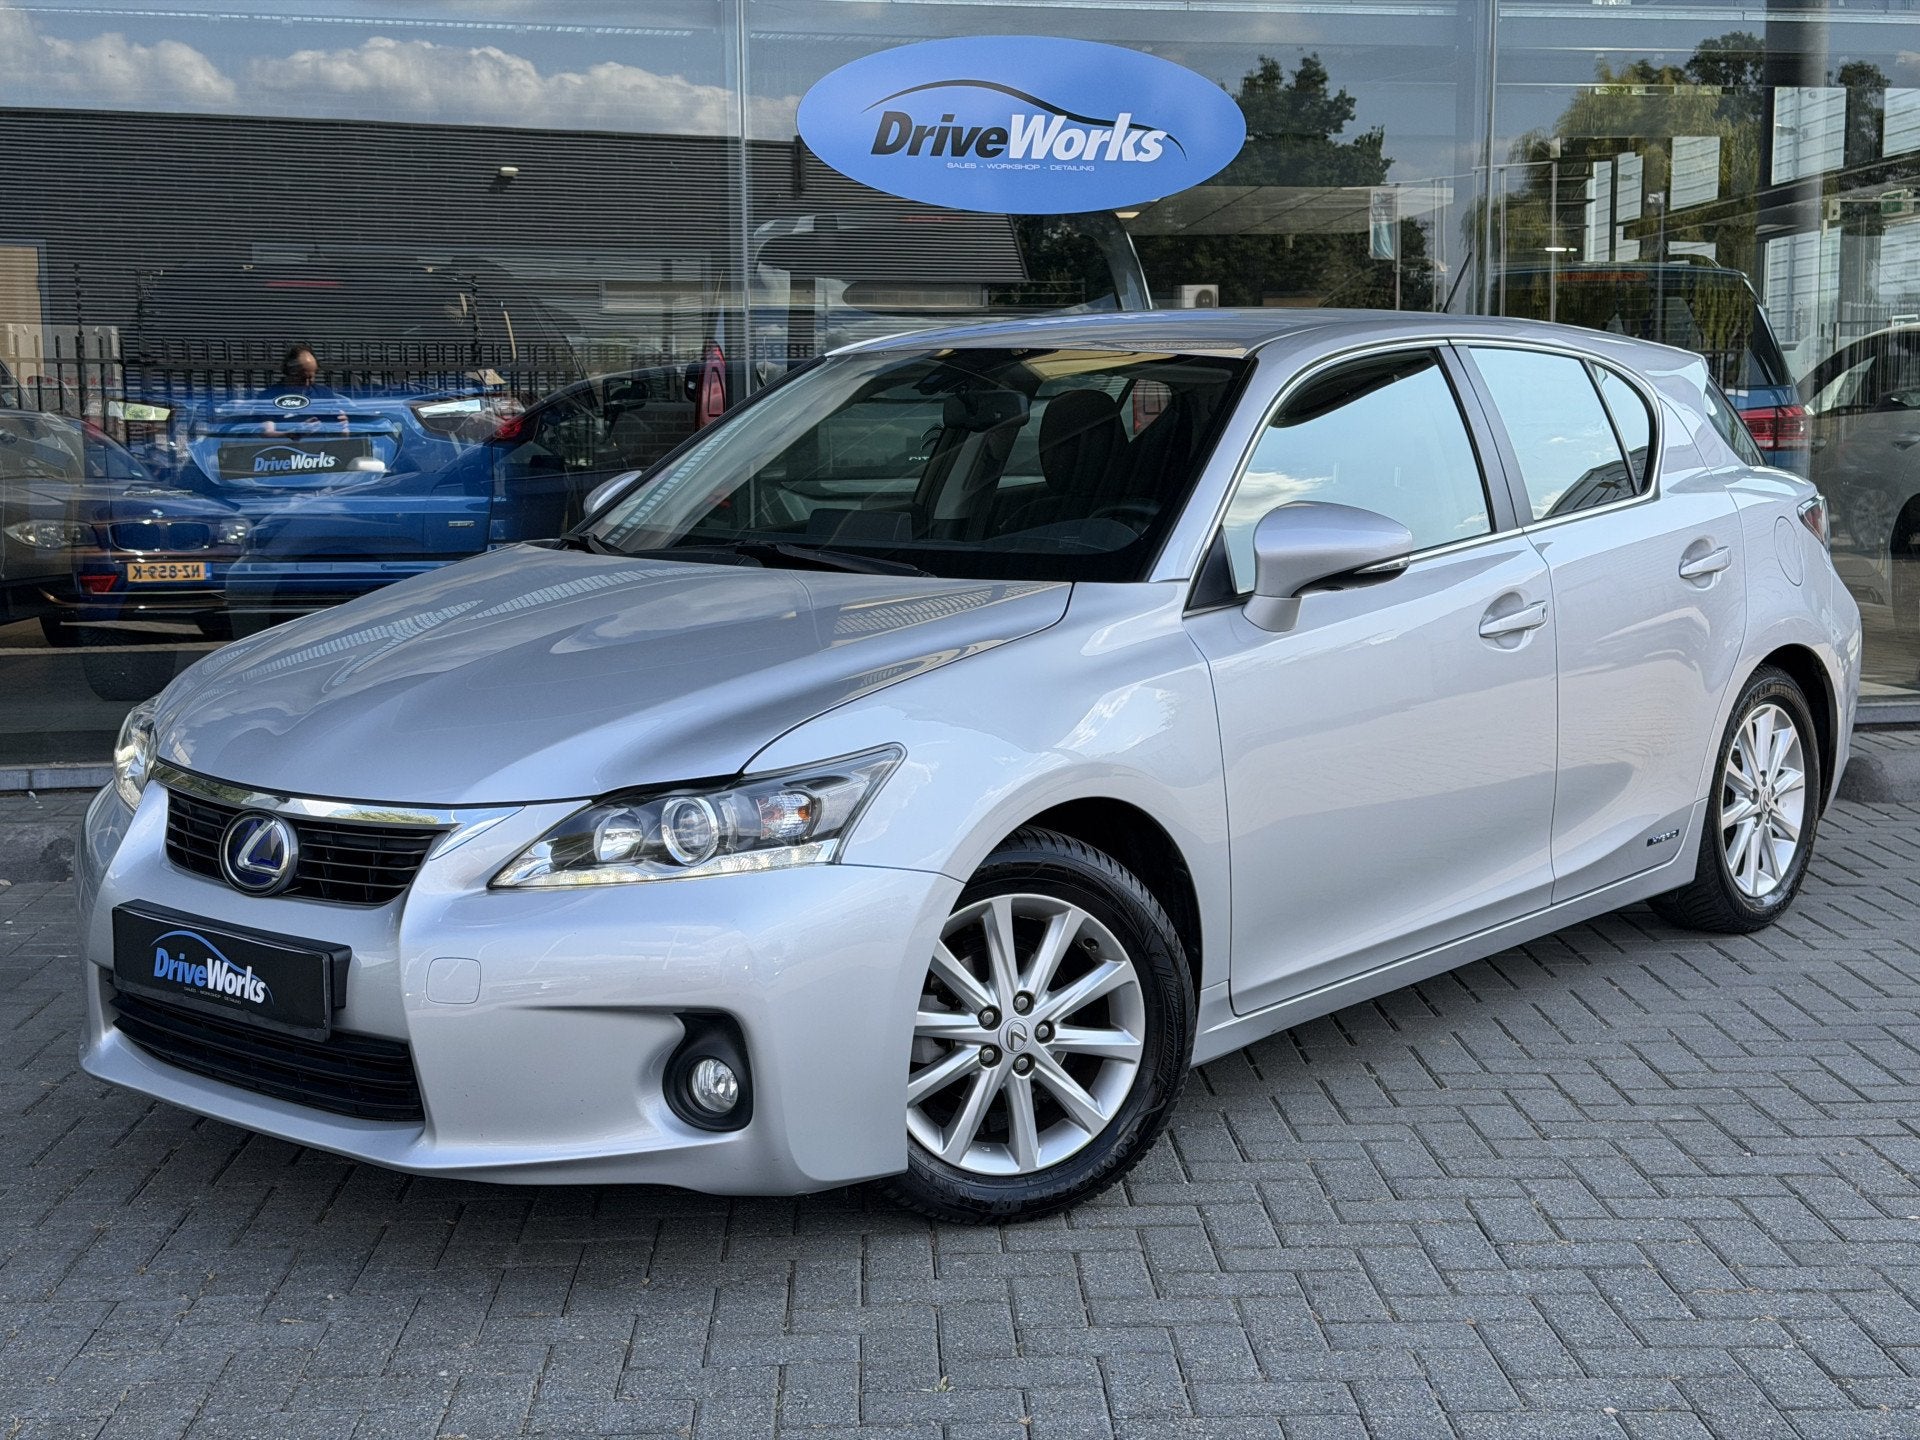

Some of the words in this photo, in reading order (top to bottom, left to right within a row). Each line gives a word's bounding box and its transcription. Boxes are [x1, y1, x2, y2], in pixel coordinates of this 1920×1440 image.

[870, 110, 1168, 163] DriveWorks
[1050, 164, 1095, 172] DETAILING
[253, 451, 336, 472] DriveWorks
[153, 947, 266, 1004] DriveWorks
